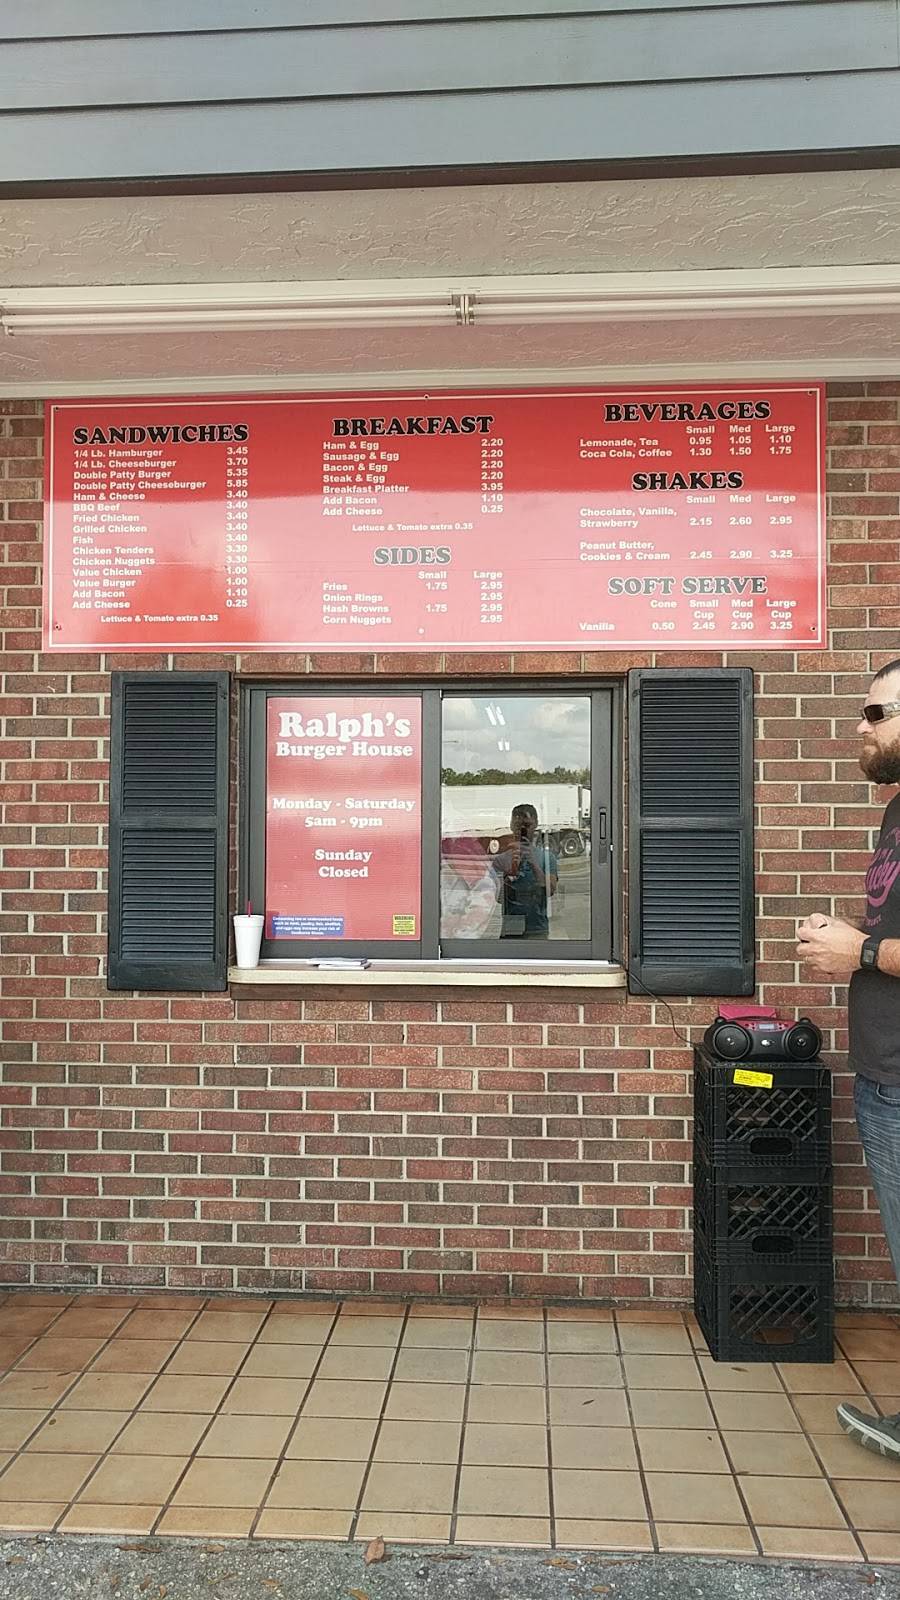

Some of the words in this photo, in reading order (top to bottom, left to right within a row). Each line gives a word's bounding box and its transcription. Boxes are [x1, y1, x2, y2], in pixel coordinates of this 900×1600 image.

[605, 401, 771, 422] BEVERAGES
[333, 416, 493, 436] BREAKFAST
[686, 425, 715, 434] Small
[730, 425, 751, 433] Med
[765, 424, 795, 434] Large
[73, 424, 248, 445] SANDWICHES
[323, 442, 346, 450] Ham
[360, 441, 379, 451] Egg
[580, 438, 636, 448] Lemonade,
[639, 438, 658, 446] Tea
[690, 437, 711, 445] 0.95
[730, 436, 751, 444] 1.05
[109, 449, 163, 459] Hamburger
[323, 453, 366, 462] Sausage
[369, 452, 376, 460] &
[380, 452, 399, 462] Egg
[580, 450, 606, 458] Coca
[609, 449, 635, 459] Cola,
[639, 449, 672, 457] Coffee
[690, 448, 711, 456] 1.30
[770, 447, 791, 455] 1.75
[109, 459, 176, 469] Cheeseburger
[323, 464, 354, 472] Bacon
[369, 463, 388, 473] Egg
[73, 471, 107, 480] Double
[110, 471, 135, 481] Patty
[138, 470, 171, 480] Burger
[323, 475, 352, 483] Steak
[366, 474, 385, 484] Egg
[482, 472, 503, 480] 2.20
[632, 471, 743, 490] SHAKES
[73, 482, 107, 490] Double
[110, 481, 135, 491] Patty
[138, 480, 206, 490] Cheeseburger
[323, 485, 372, 494] Breakfast
[375, 485, 409, 493] Platter
[73, 493, 96, 501] Ham
[109, 492, 145, 500] Cheese
[227, 490, 247, 498] 3.40
[482, 494, 503, 502] 1.10
[730, 495, 751, 503] Med
[766, 494, 796, 504] Large
[226, 501, 247, 509] 3.40
[346, 496, 377, 504] Bacon
[73, 504, 94, 512] BBQ
[98, 503, 121, 511] Beef
[346, 507, 382, 515] Cheese
[481, 505, 503, 513] 0.25
[580, 508, 635, 518] Chocolate,
[639, 507, 677, 517] Vanilla,
[73, 514, 98, 522] Fried
[100, 514, 139, 522] Chicken
[226, 512, 247, 520] 3.40
[226, 523, 247, 531] 3.40
[431, 523, 453, 531] extra
[580, 519, 638, 529] Strawberry
[730, 517, 752, 525] 2.60
[73, 525, 105, 533] Grilled
[108, 525, 147, 533] Chicken
[73, 536, 93, 544] Fish
[73, 546, 112, 555] Chicken
[115, 546, 154, 554] Tenders
[580, 542, 616, 550] Peanut
[620, 541, 654, 550] Butter,
[374, 546, 451, 565] SIDES
[580, 552, 621, 560] Cookies
[625, 552, 632, 560] &
[636, 552, 670, 560] Cream
[770, 550, 792, 558] 3.25
[73, 557, 112, 566] Chicken
[115, 557, 155, 567] Nuggets
[73, 568, 100, 576] Value
[103, 568, 142, 576] Chicken
[418, 571, 447, 579] Small
[473, 571, 502, 580] Large
[73, 579, 100, 587] Value
[103, 579, 136, 588] Burger
[323, 583, 347, 591] Fries
[426, 582, 447, 590] 1.75
[608, 577, 675, 595] SOFT
[681, 576, 767, 595] SERVE
[323, 594, 351, 602] Onion
[355, 594, 383, 603] Rings
[651, 600, 677, 608] Cone
[690, 600, 718, 608] Small
[732, 599, 753, 607] Med
[767, 599, 796, 608] Large
[73, 601, 91, 609] Add
[323, 605, 348, 613] Hash
[351, 605, 389, 613] Browns
[426, 604, 447, 612] 1.75
[480, 604, 502, 612] 2.95
[323, 616, 347, 624] Corn
[350, 616, 391, 625] Nuggets
[480, 615, 502, 623] 2.95
[694, 611, 714, 621] Cup
[732, 611, 753, 620] Cup
[771, 611, 791, 620] Cup
[580, 623, 614, 631] Vanilla
[652, 622, 674, 630] 0.50
[693, 622, 715, 630] 2.45
[731, 622, 754, 630] 2.90
[770, 622, 792, 630] 3.25
[279, 712, 411, 742] Ralph's
[276, 742, 346, 759] Burger
[352, 742, 413, 756] House
[272, 798, 332, 811] Monday
[345, 798, 415, 811] Saturday
[305, 816, 336, 828] 5am
[350, 817, 383, 828] 9pm
[315, 849, 372, 863] Sunday
[318, 867, 368, 878] Closed
